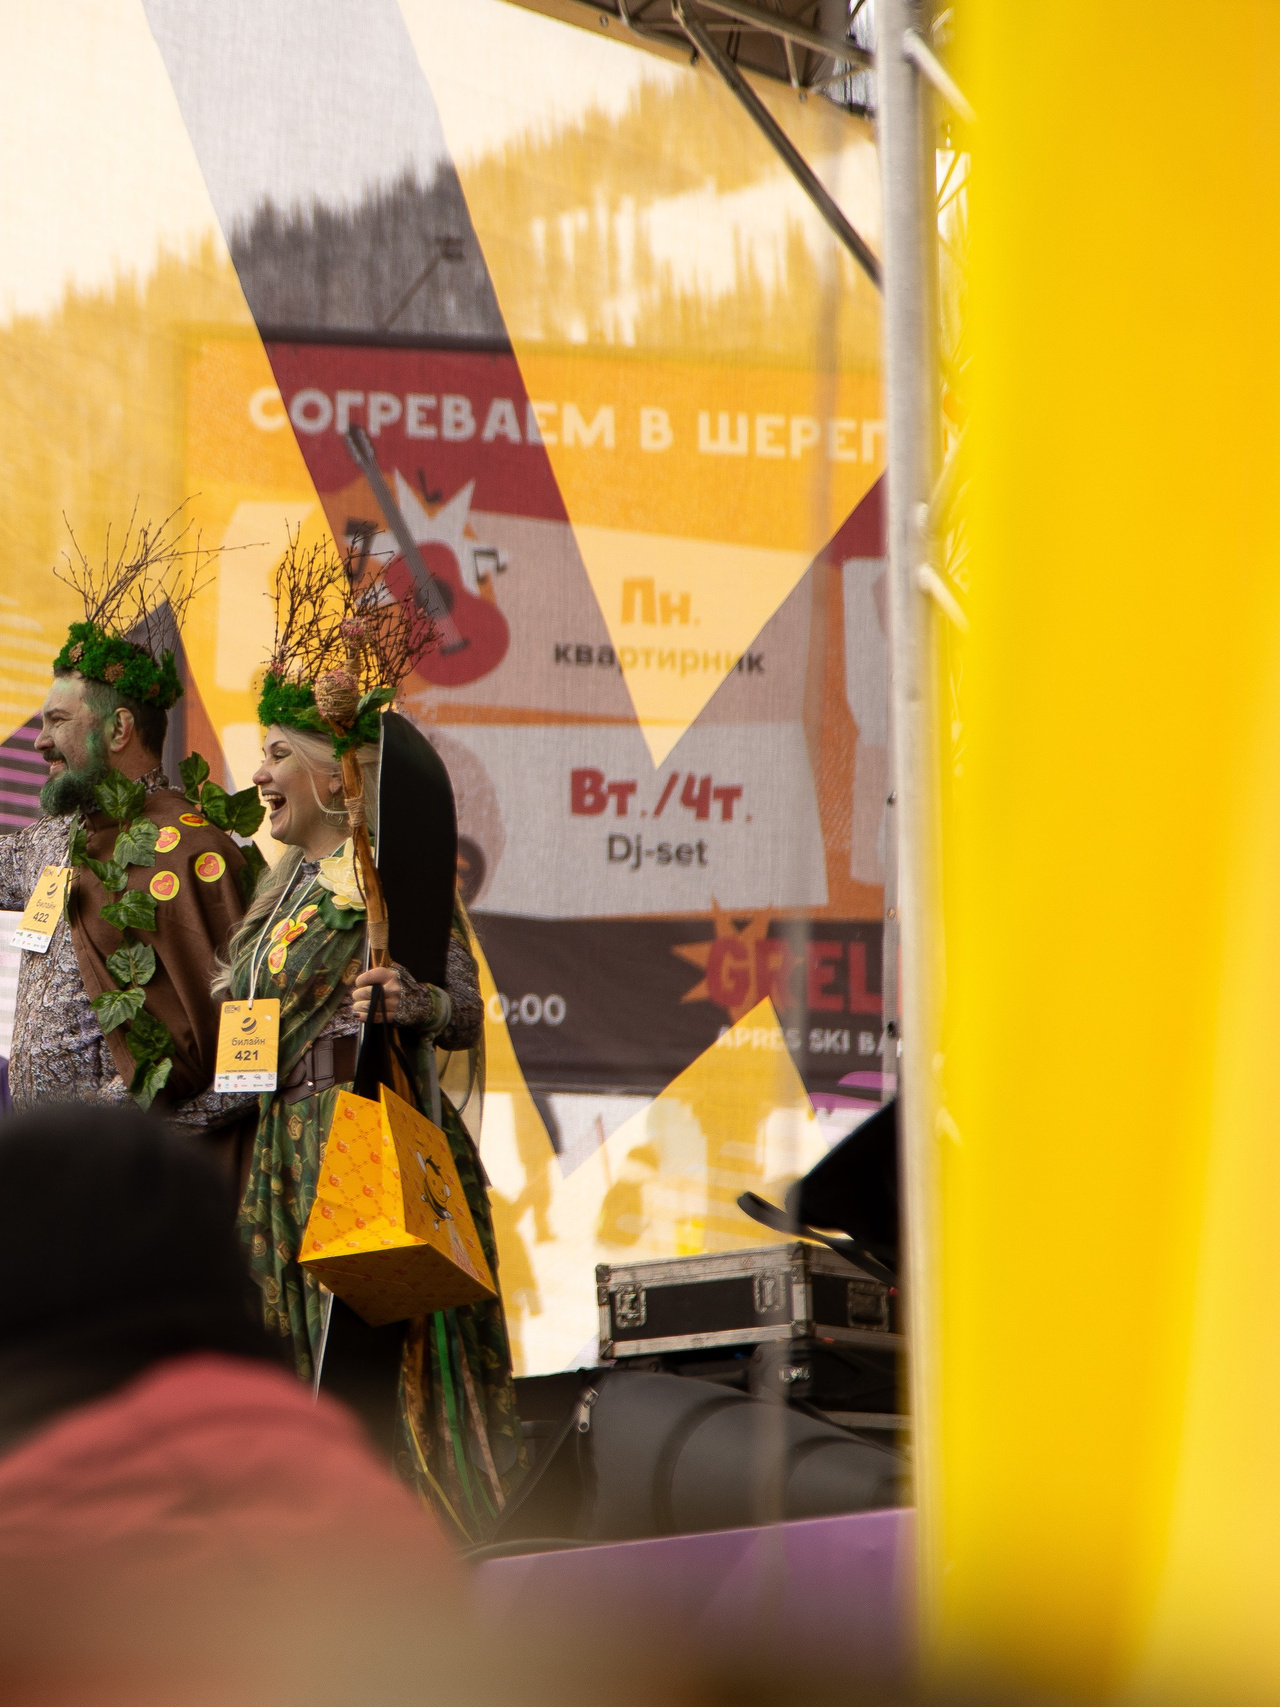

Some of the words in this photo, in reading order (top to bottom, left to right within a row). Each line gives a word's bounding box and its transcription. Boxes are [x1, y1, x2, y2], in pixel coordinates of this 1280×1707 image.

[249, 387, 615, 449] СОГРЕВАЕМ
[639, 406, 673, 451] В
[621, 577, 700, 627] Пн.
[554, 642, 765, 679] квартирник
[606, 832, 708, 872] Dj-set
[32, 911, 50, 924] 422
[706, 935, 903, 1018] GREL
[231, 1036, 266, 1046] билайн
[234, 1050, 259, 1061] 421
[808, 1028, 850, 1055] SKI
